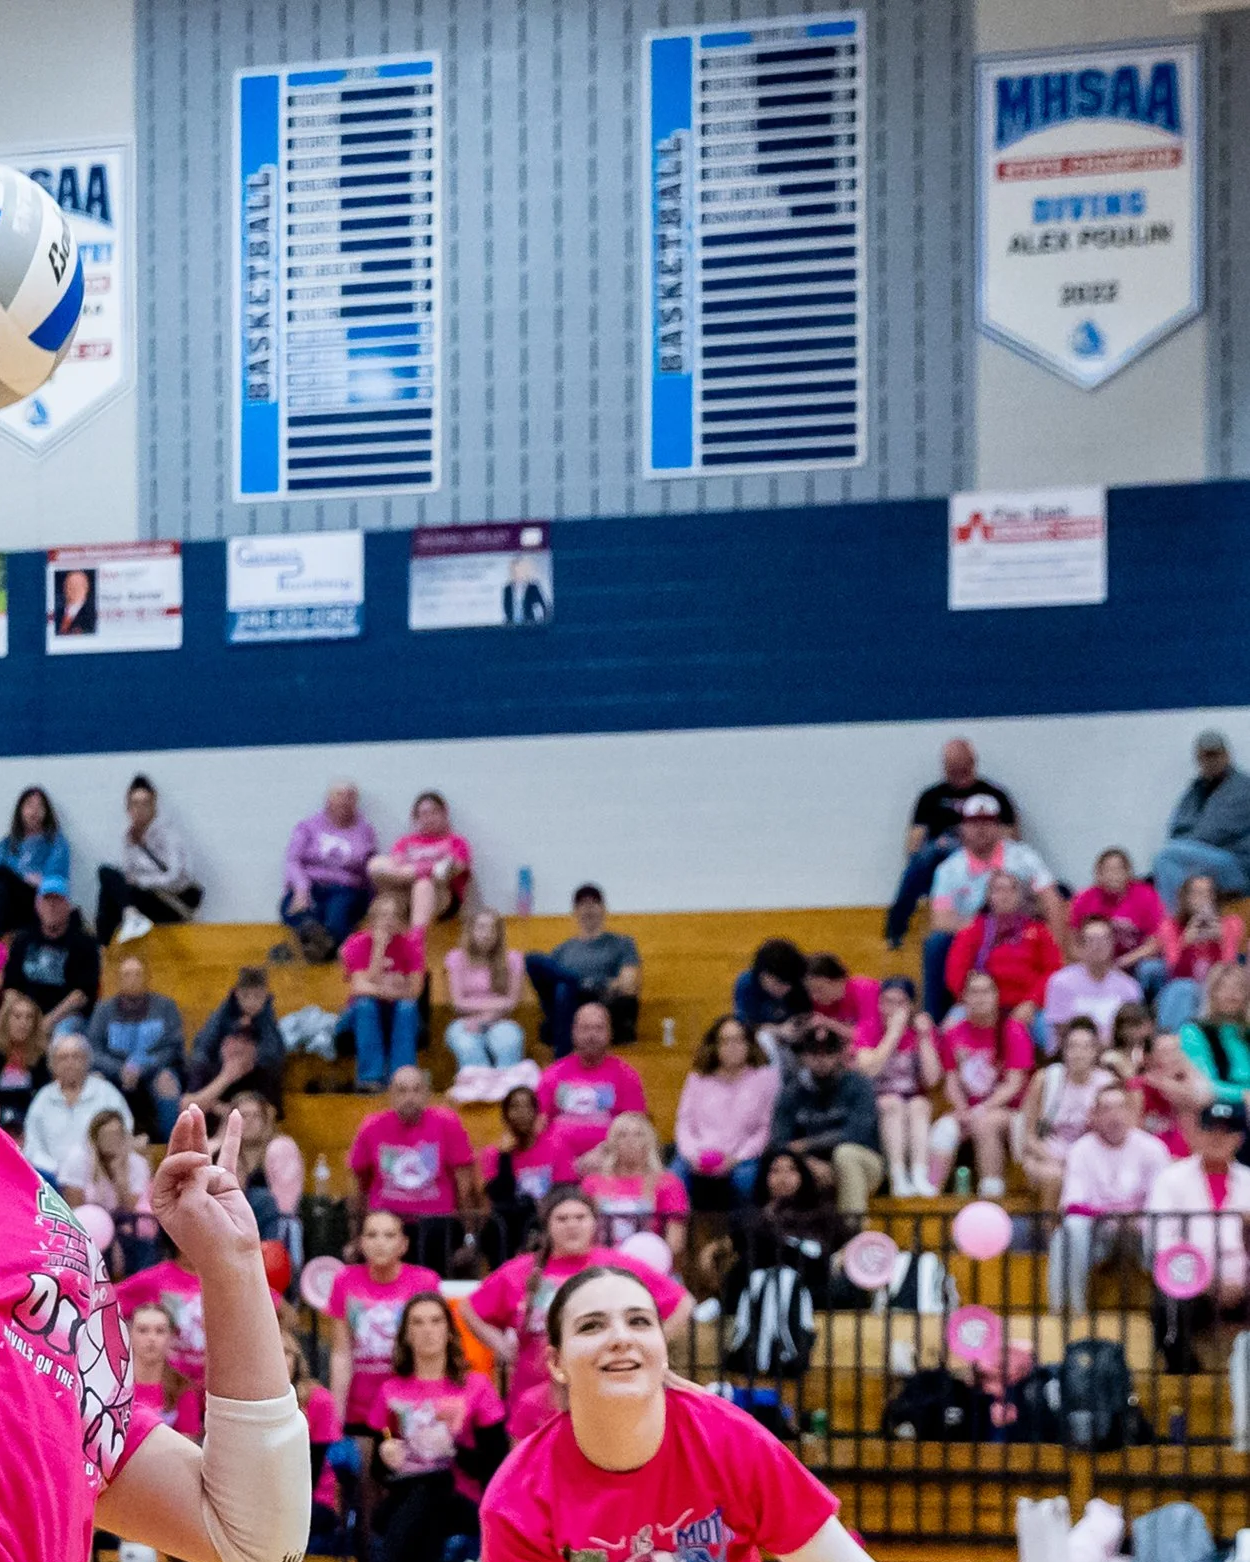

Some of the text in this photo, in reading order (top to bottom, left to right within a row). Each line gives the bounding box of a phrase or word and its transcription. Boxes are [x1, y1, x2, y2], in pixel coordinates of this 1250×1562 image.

[996, 62, 1181, 150] MHSAA
[26, 163, 114, 223] SAA
[1033, 190, 1145, 223] DIVING
[247, 171, 270, 402] BASKETBALL
[659, 137, 682, 373] BASKETBALL
[35, 1354, 54, 1375] ON
[55, 1364, 75, 1390] THE
